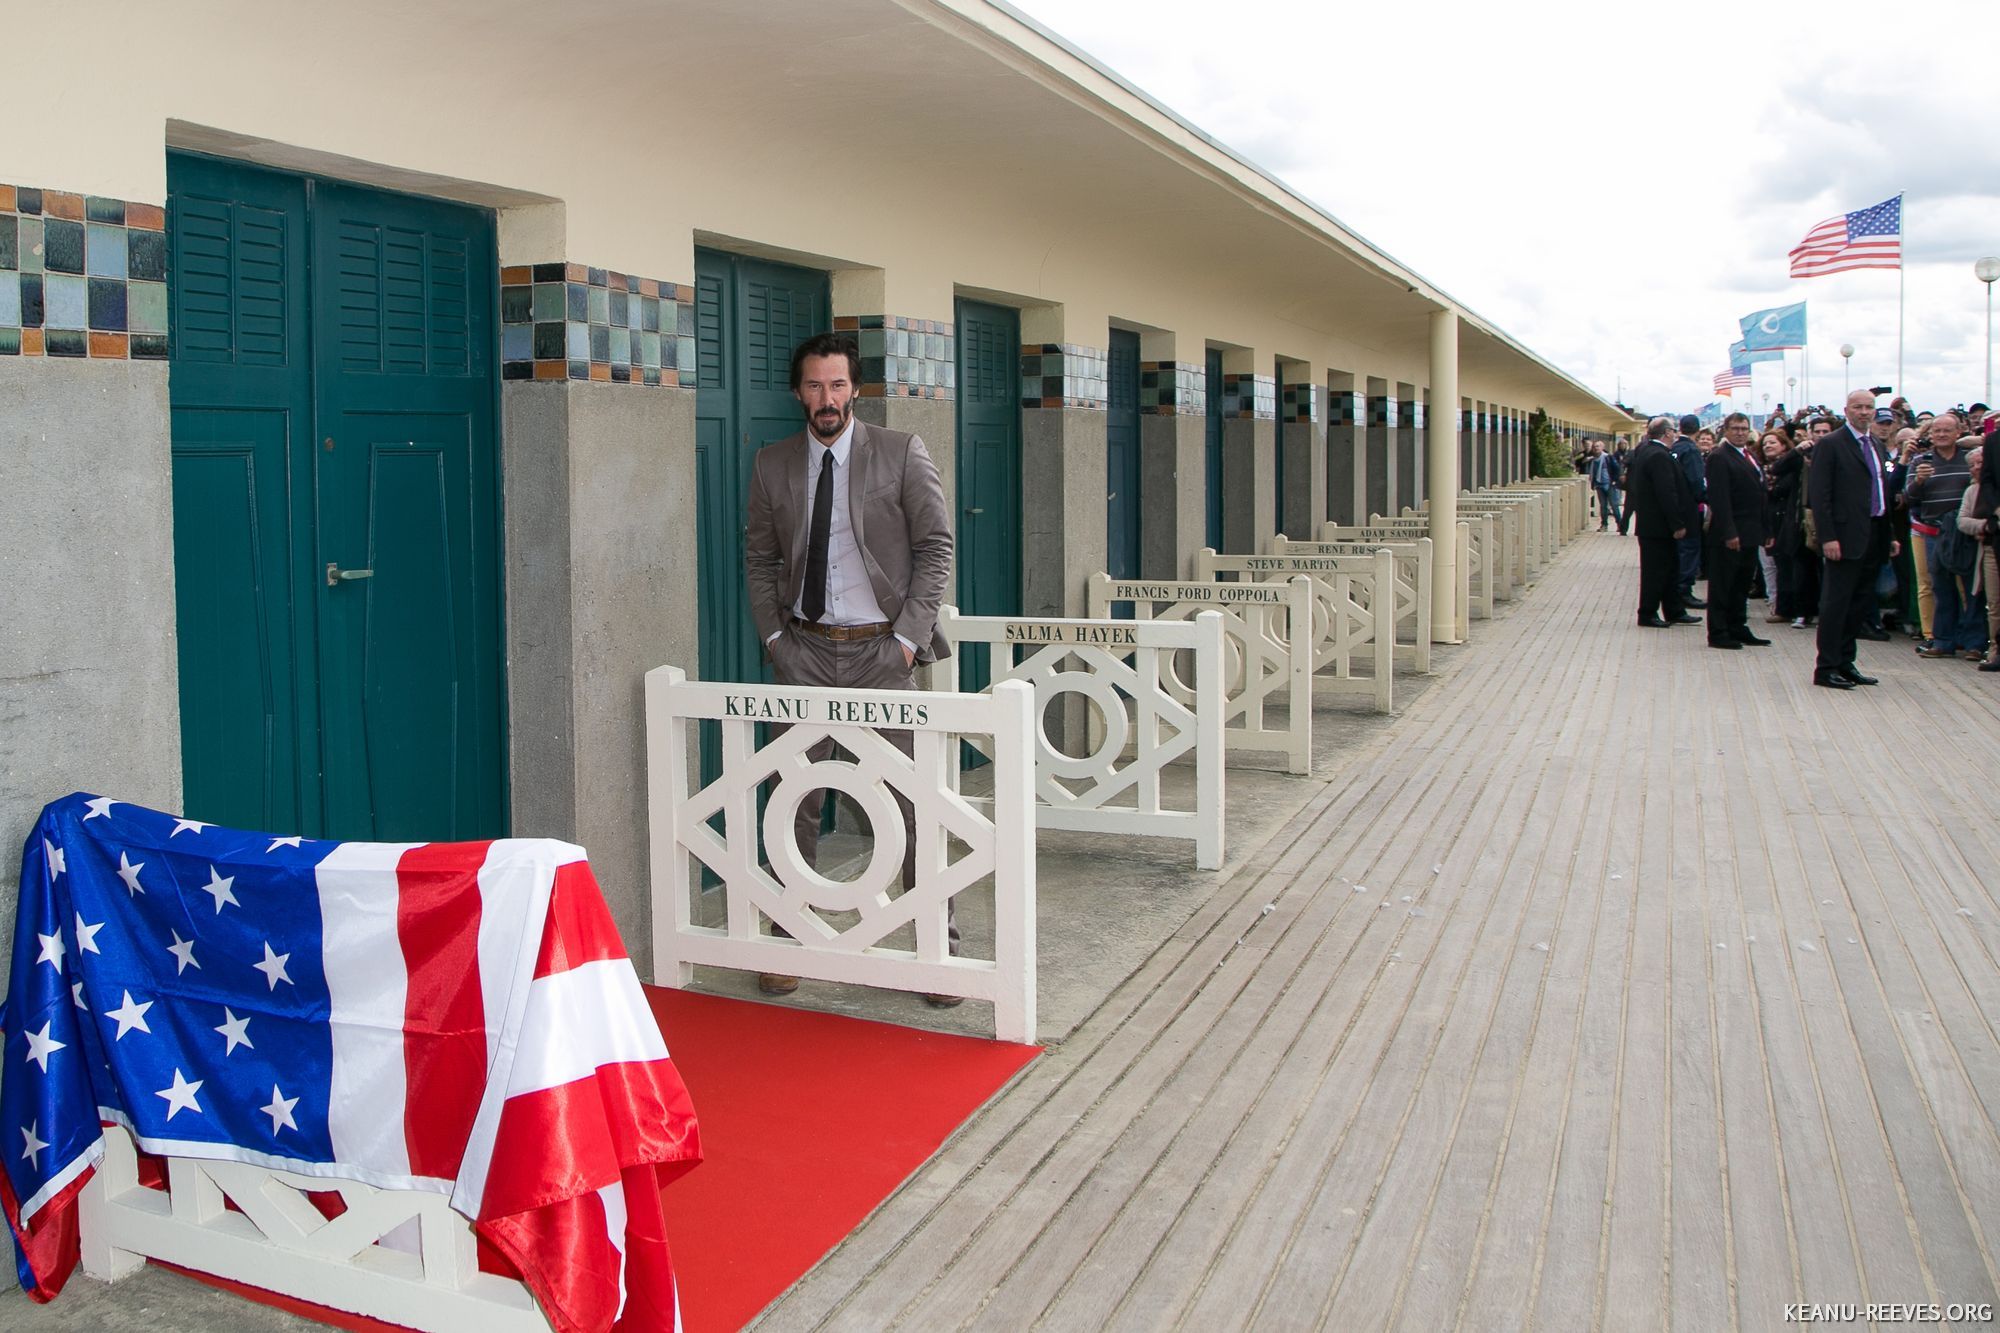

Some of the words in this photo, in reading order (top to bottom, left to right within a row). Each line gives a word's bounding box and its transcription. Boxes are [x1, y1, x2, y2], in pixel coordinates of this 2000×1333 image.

[1360, 530, 1385, 538] ADAM
[1318, 545, 1345, 555] RENE
[1352, 545, 1385, 555] RUSS
[1246, 559, 1285, 570] STEVE
[1291, 559, 1339, 571] MARTIN
[1116, 585, 1169, 599] FRANCIS
[1177, 586, 1211, 600] FORD
[1219, 588, 1280, 602] COPPOLA
[1006, 624, 1063, 641] SALMA
[1075, 626, 1137, 643] HAYEK
[724, 695, 810, 720] KEANU
[827, 700, 929, 725] REEVES
